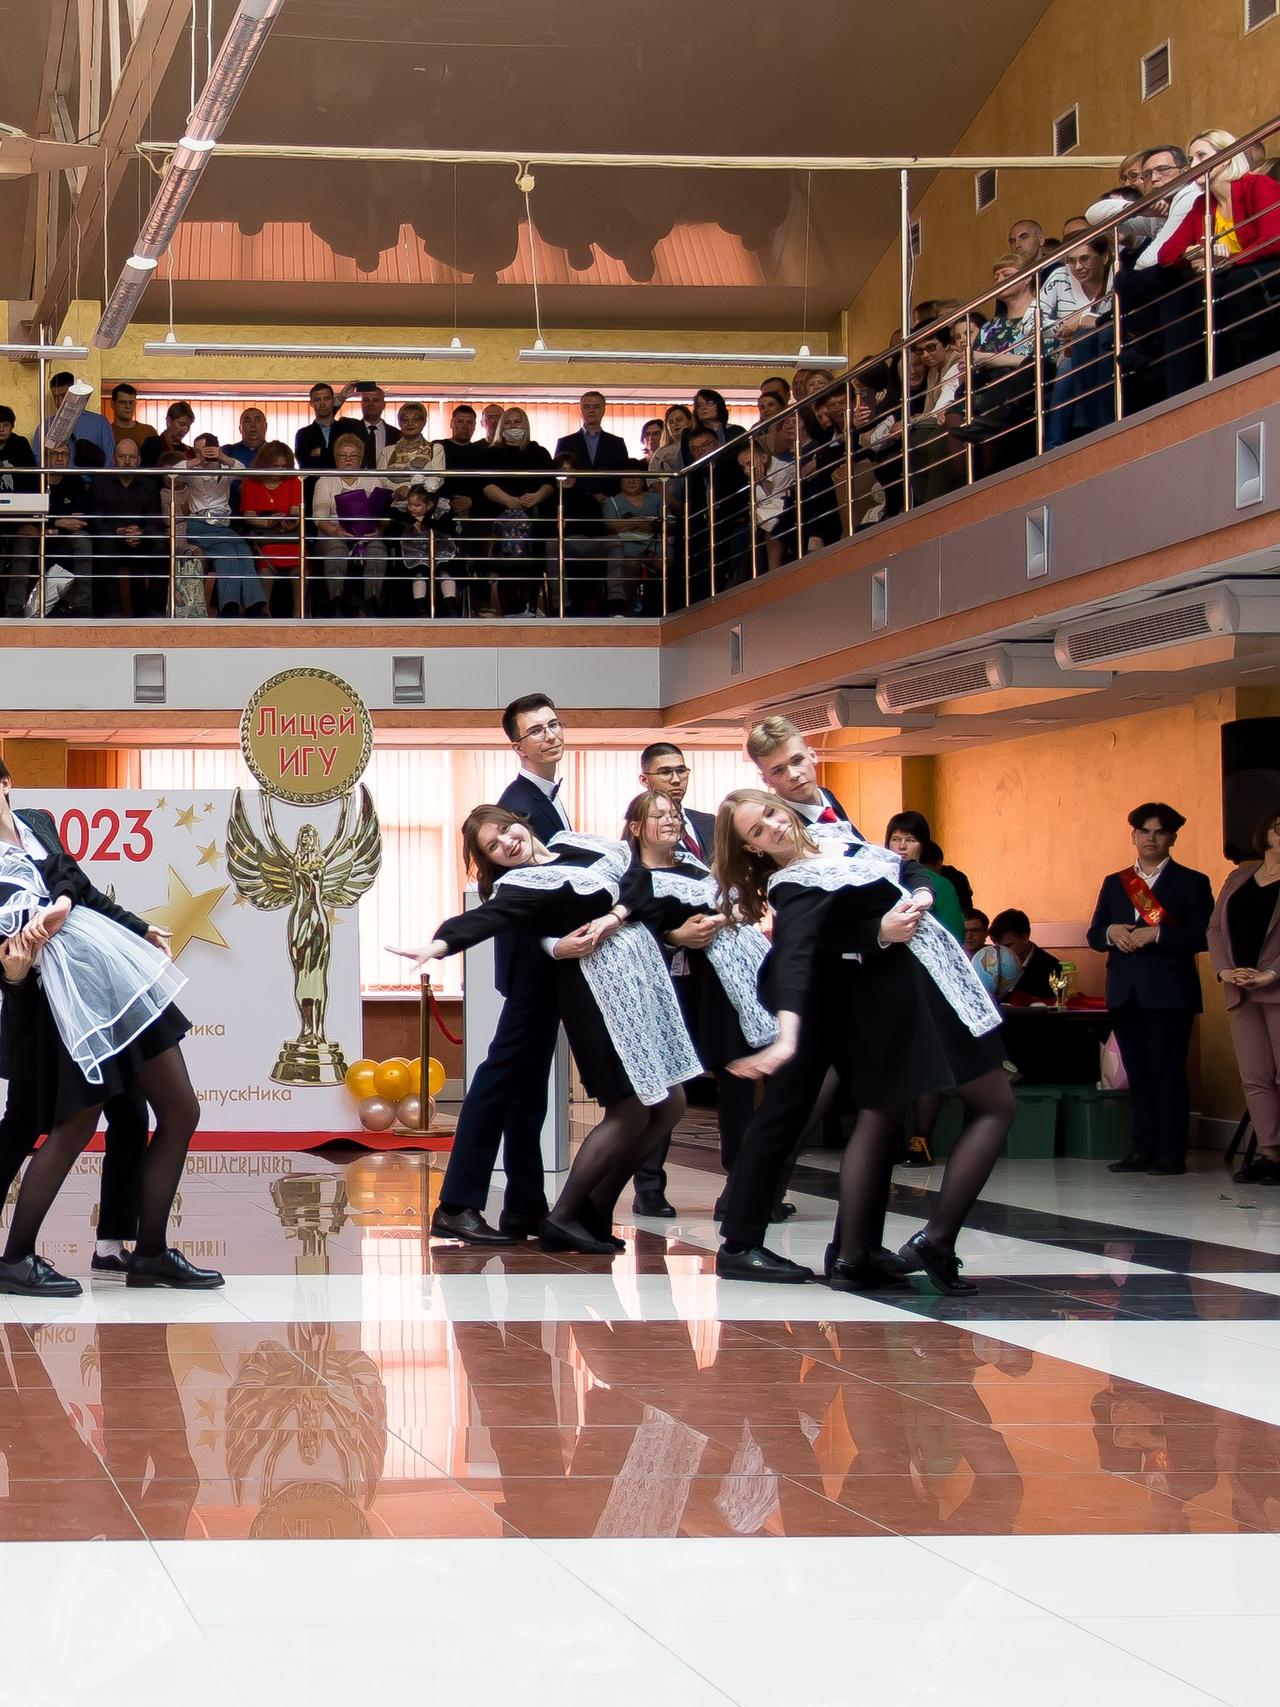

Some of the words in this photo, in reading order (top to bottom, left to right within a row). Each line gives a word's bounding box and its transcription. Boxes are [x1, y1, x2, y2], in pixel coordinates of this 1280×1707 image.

[256, 706, 355, 740] Лицей
[279, 745, 338, 778] ИГУ
[42, 808, 154, 862] 023
[195, 1086, 292, 1107] ыпускНика
